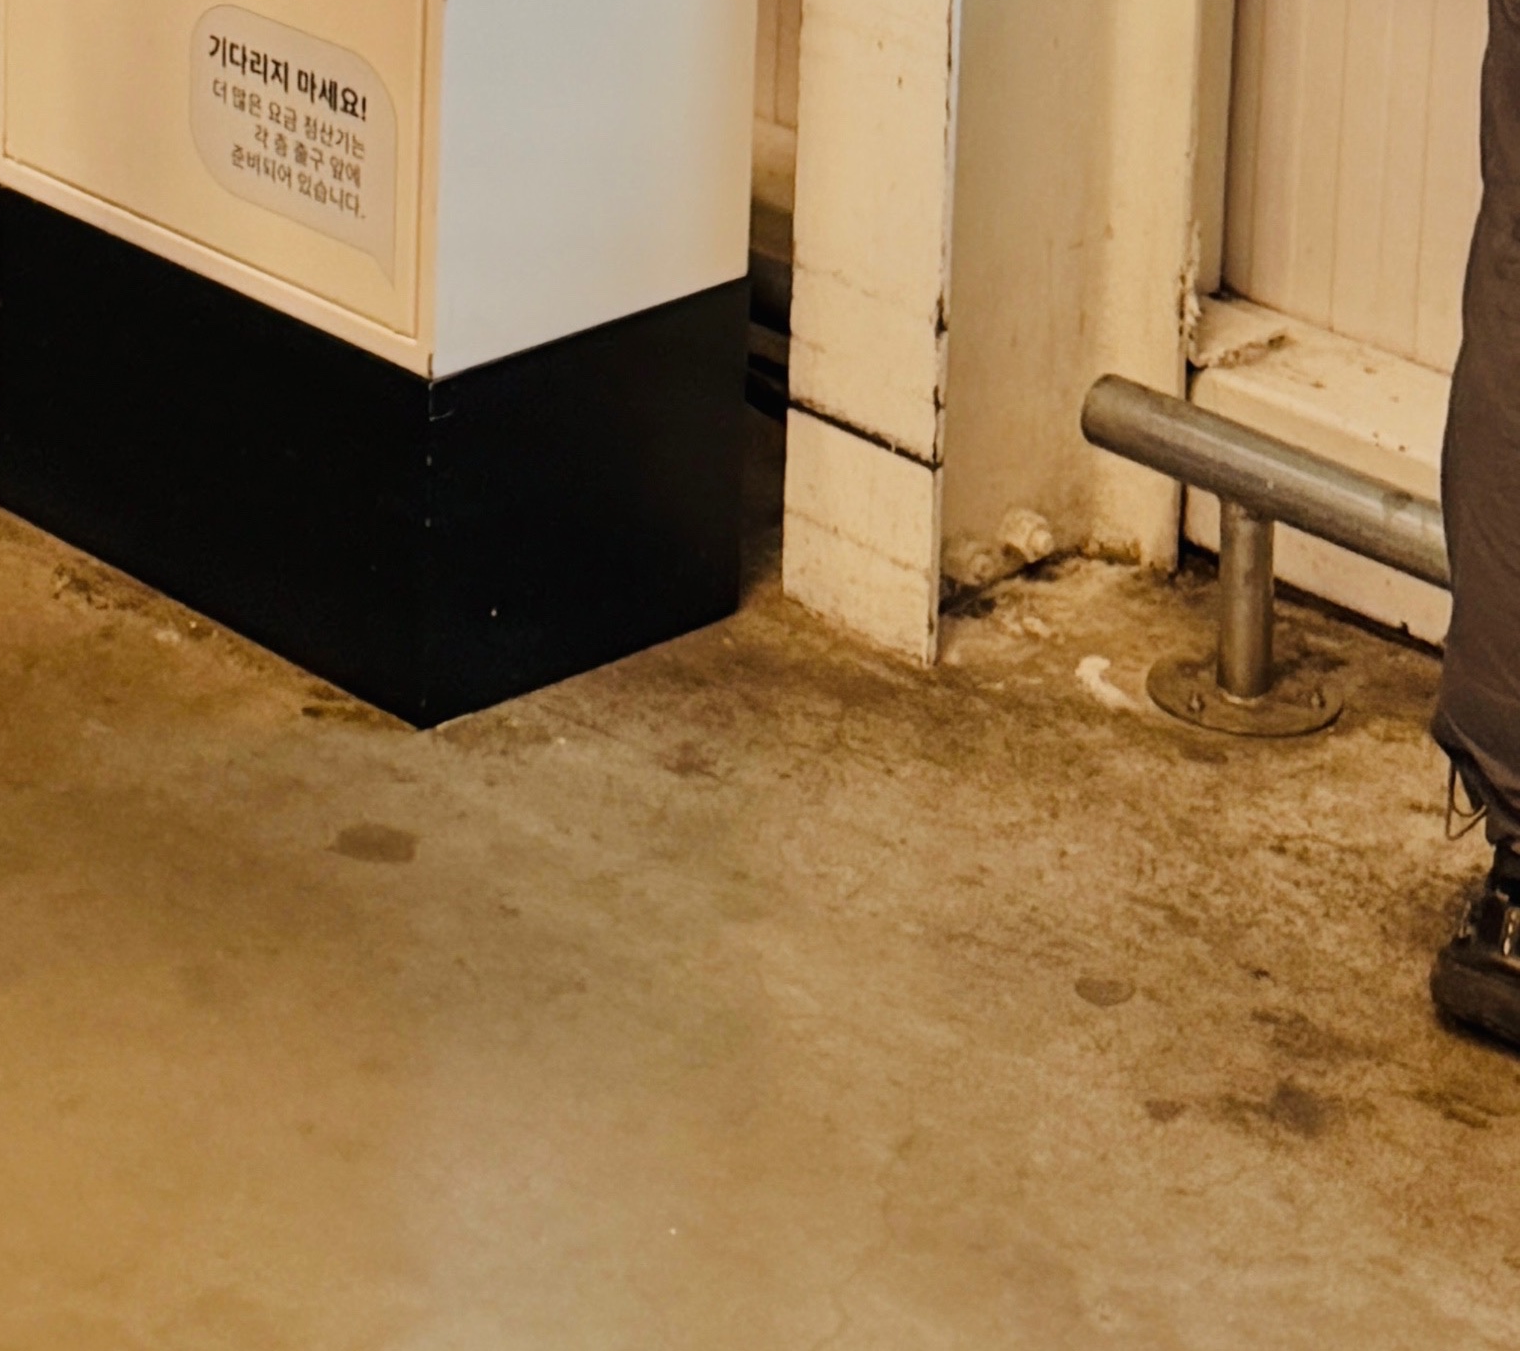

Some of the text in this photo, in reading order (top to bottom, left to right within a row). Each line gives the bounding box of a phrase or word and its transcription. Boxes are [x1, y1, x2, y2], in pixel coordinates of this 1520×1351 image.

[208, 35, 367, 121] 기다리지 마세요!
[213, 78, 365, 159] 더 많은 요금 정산기는
[254, 125, 361, 188] 각 층 출구 앞에
[231, 143, 366, 218] 준비되어 있습니다.
